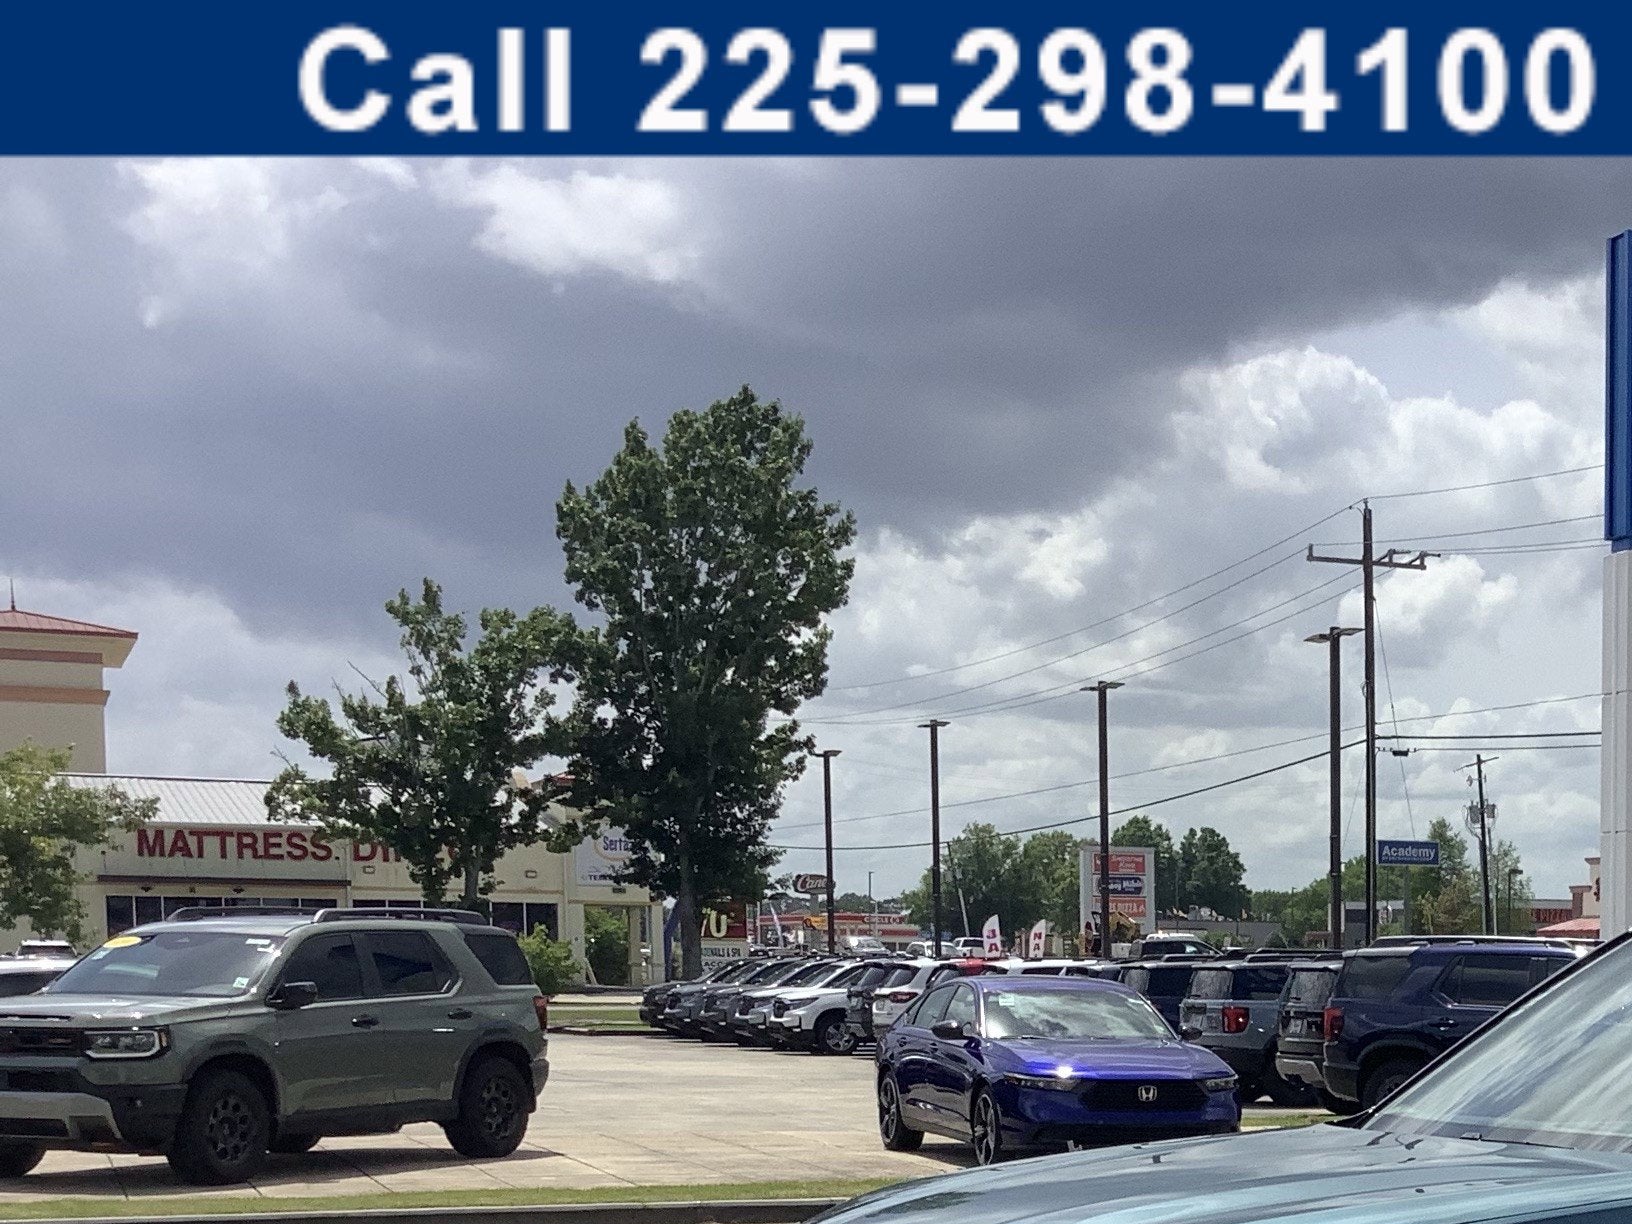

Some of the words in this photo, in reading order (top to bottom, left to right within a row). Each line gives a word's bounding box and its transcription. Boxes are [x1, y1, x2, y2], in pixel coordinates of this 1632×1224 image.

[136, 828, 333, 862] MATTRESS
[1381, 845, 1436, 860] Academy
[797, 874, 828, 892] Cane
